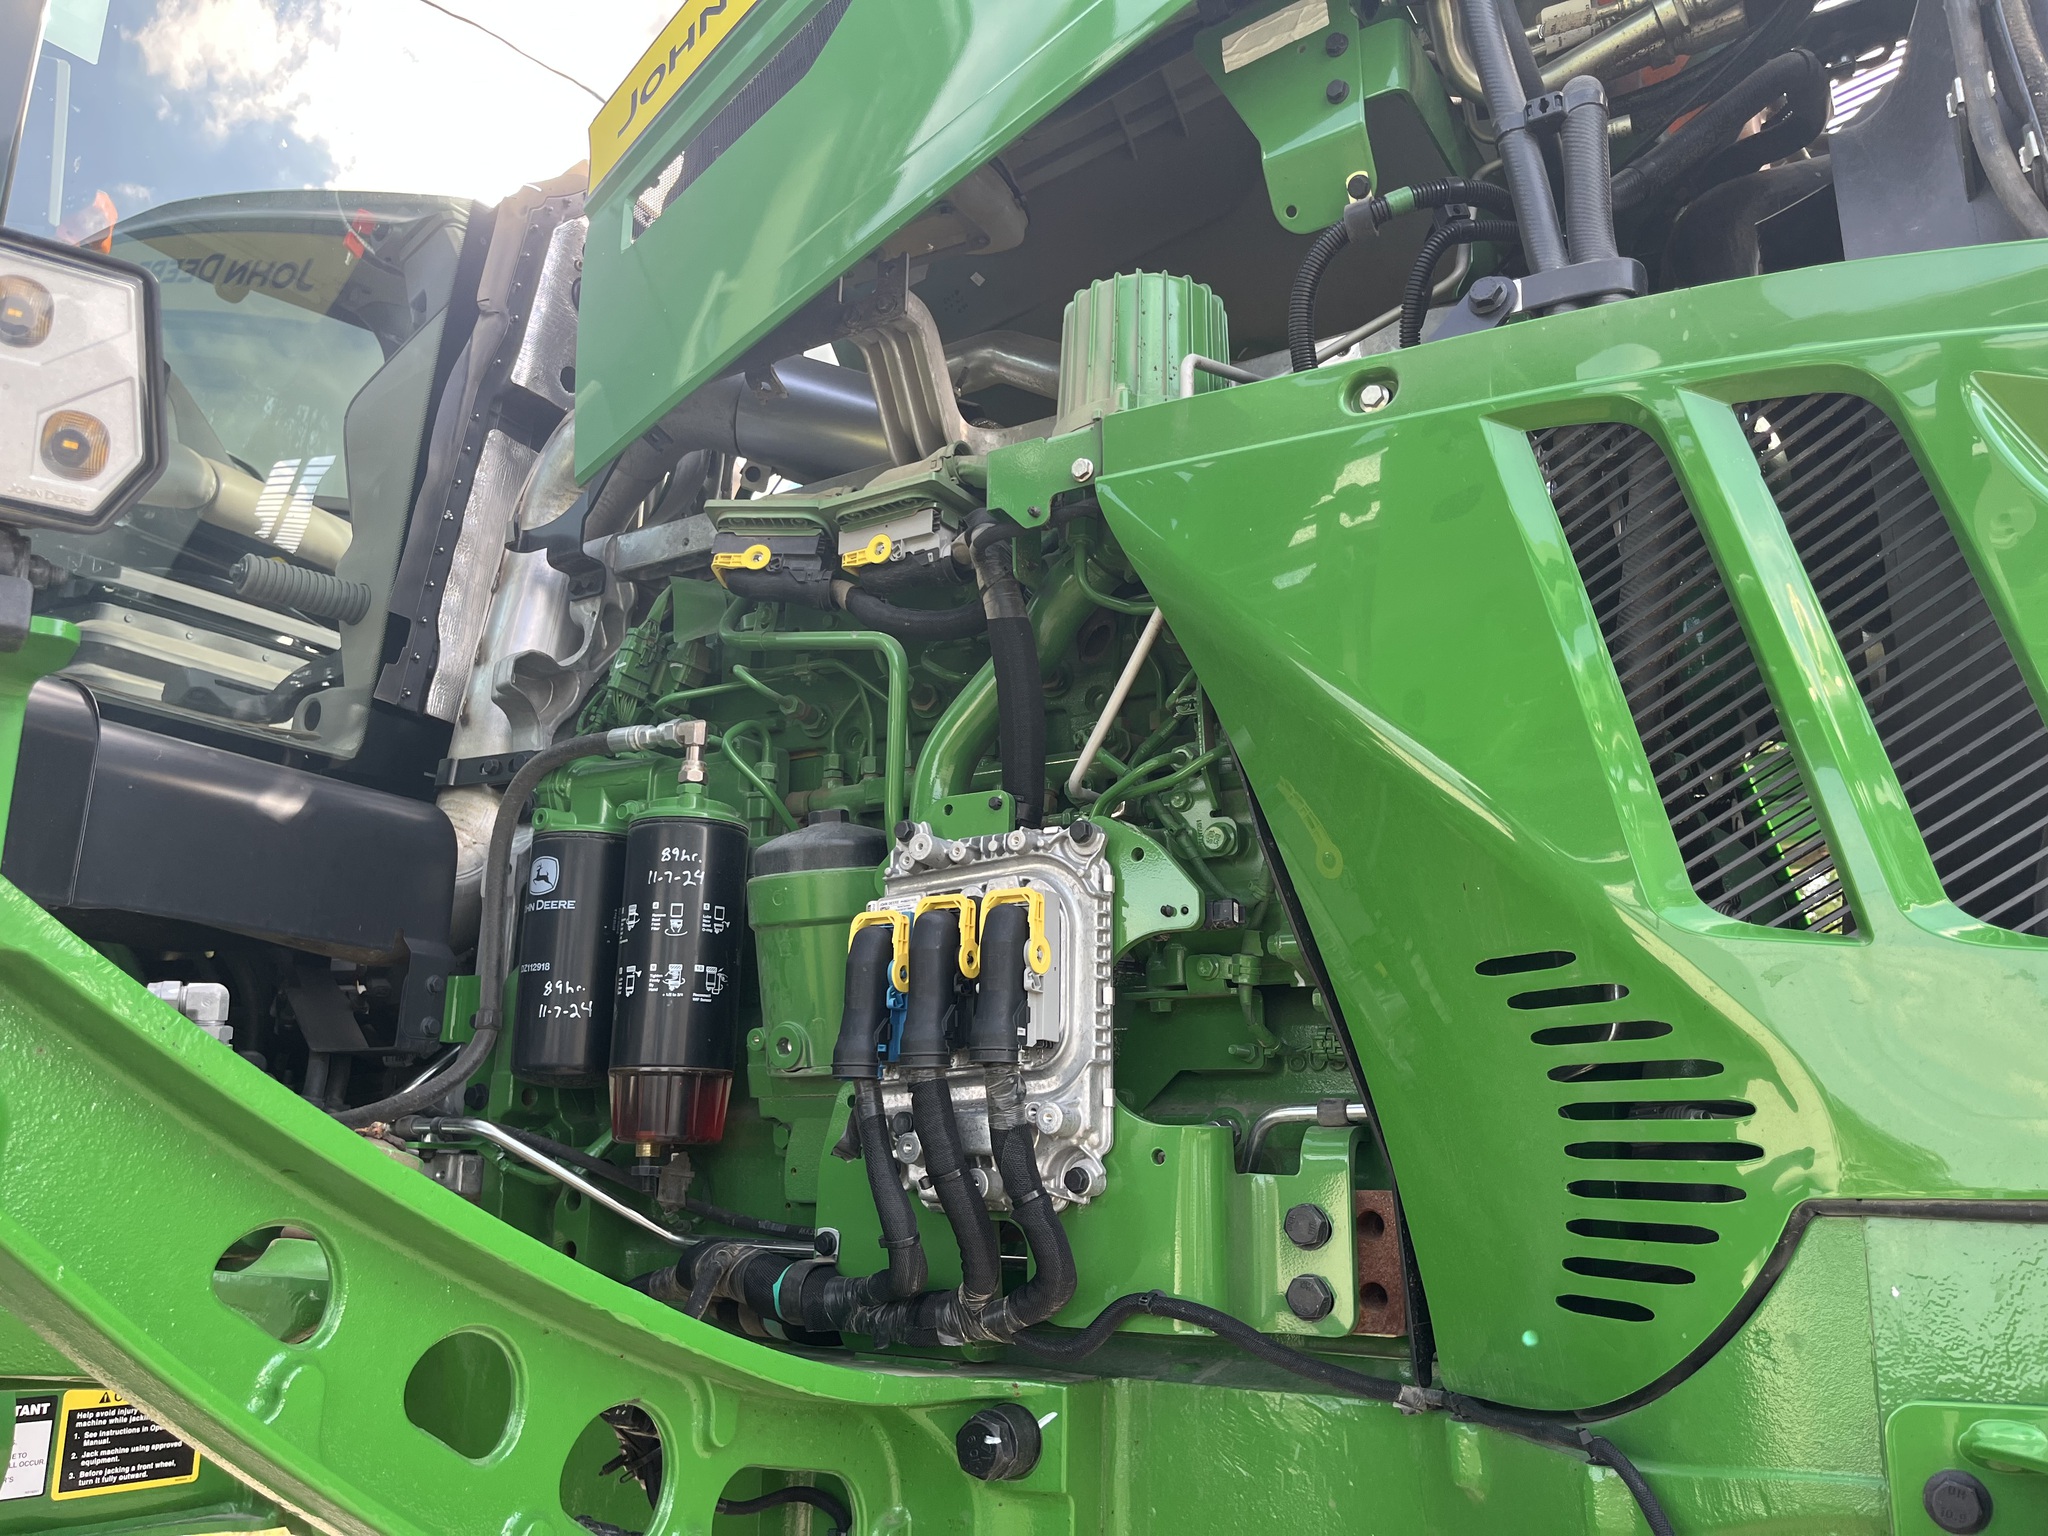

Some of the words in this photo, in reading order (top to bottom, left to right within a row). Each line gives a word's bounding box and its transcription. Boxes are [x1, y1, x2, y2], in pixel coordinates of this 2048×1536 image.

[617, 0, 727, 139] JOHN
[648, 869, 705, 887] 11-7-24
[536, 899, 577, 910] DEERE
[539, 1001, 593, 1018] 11-7-24
[15, 1403, 50, 1417] TANT
[77, 1411, 94, 1420] Help
[95, 1408, 116, 1417] avoid
[117, 1406, 138, 1416] injury
[75, 1419, 107, 1428] machine
[109, 1415, 128, 1424] while
[84, 1430, 97, 1439] See
[99, 1427, 140, 1438] instructions
[142, 1425, 148, 1433] in
[83, 1437, 111, 1447] Manual.
[81, 1450, 99, 1459] Jack
[100, 1446, 129, 1456] machine
[131, 1444, 150, 1453] using
[151, 1440, 183, 1451] approved
[81, 1456, 120, 1467] equipment.
[68, 1472, 75, 1480] 3.
[79, 1469, 103, 1479] Before
[104, 1466, 130, 1476] jacking
[137, 1462, 154, 1471] front
[155, 1460, 177, 1469] wheel,
[95, 1476, 101, 1484] it
[102, 1474, 118, 1484] fully
[119, 1471, 149, 1480] outward.
